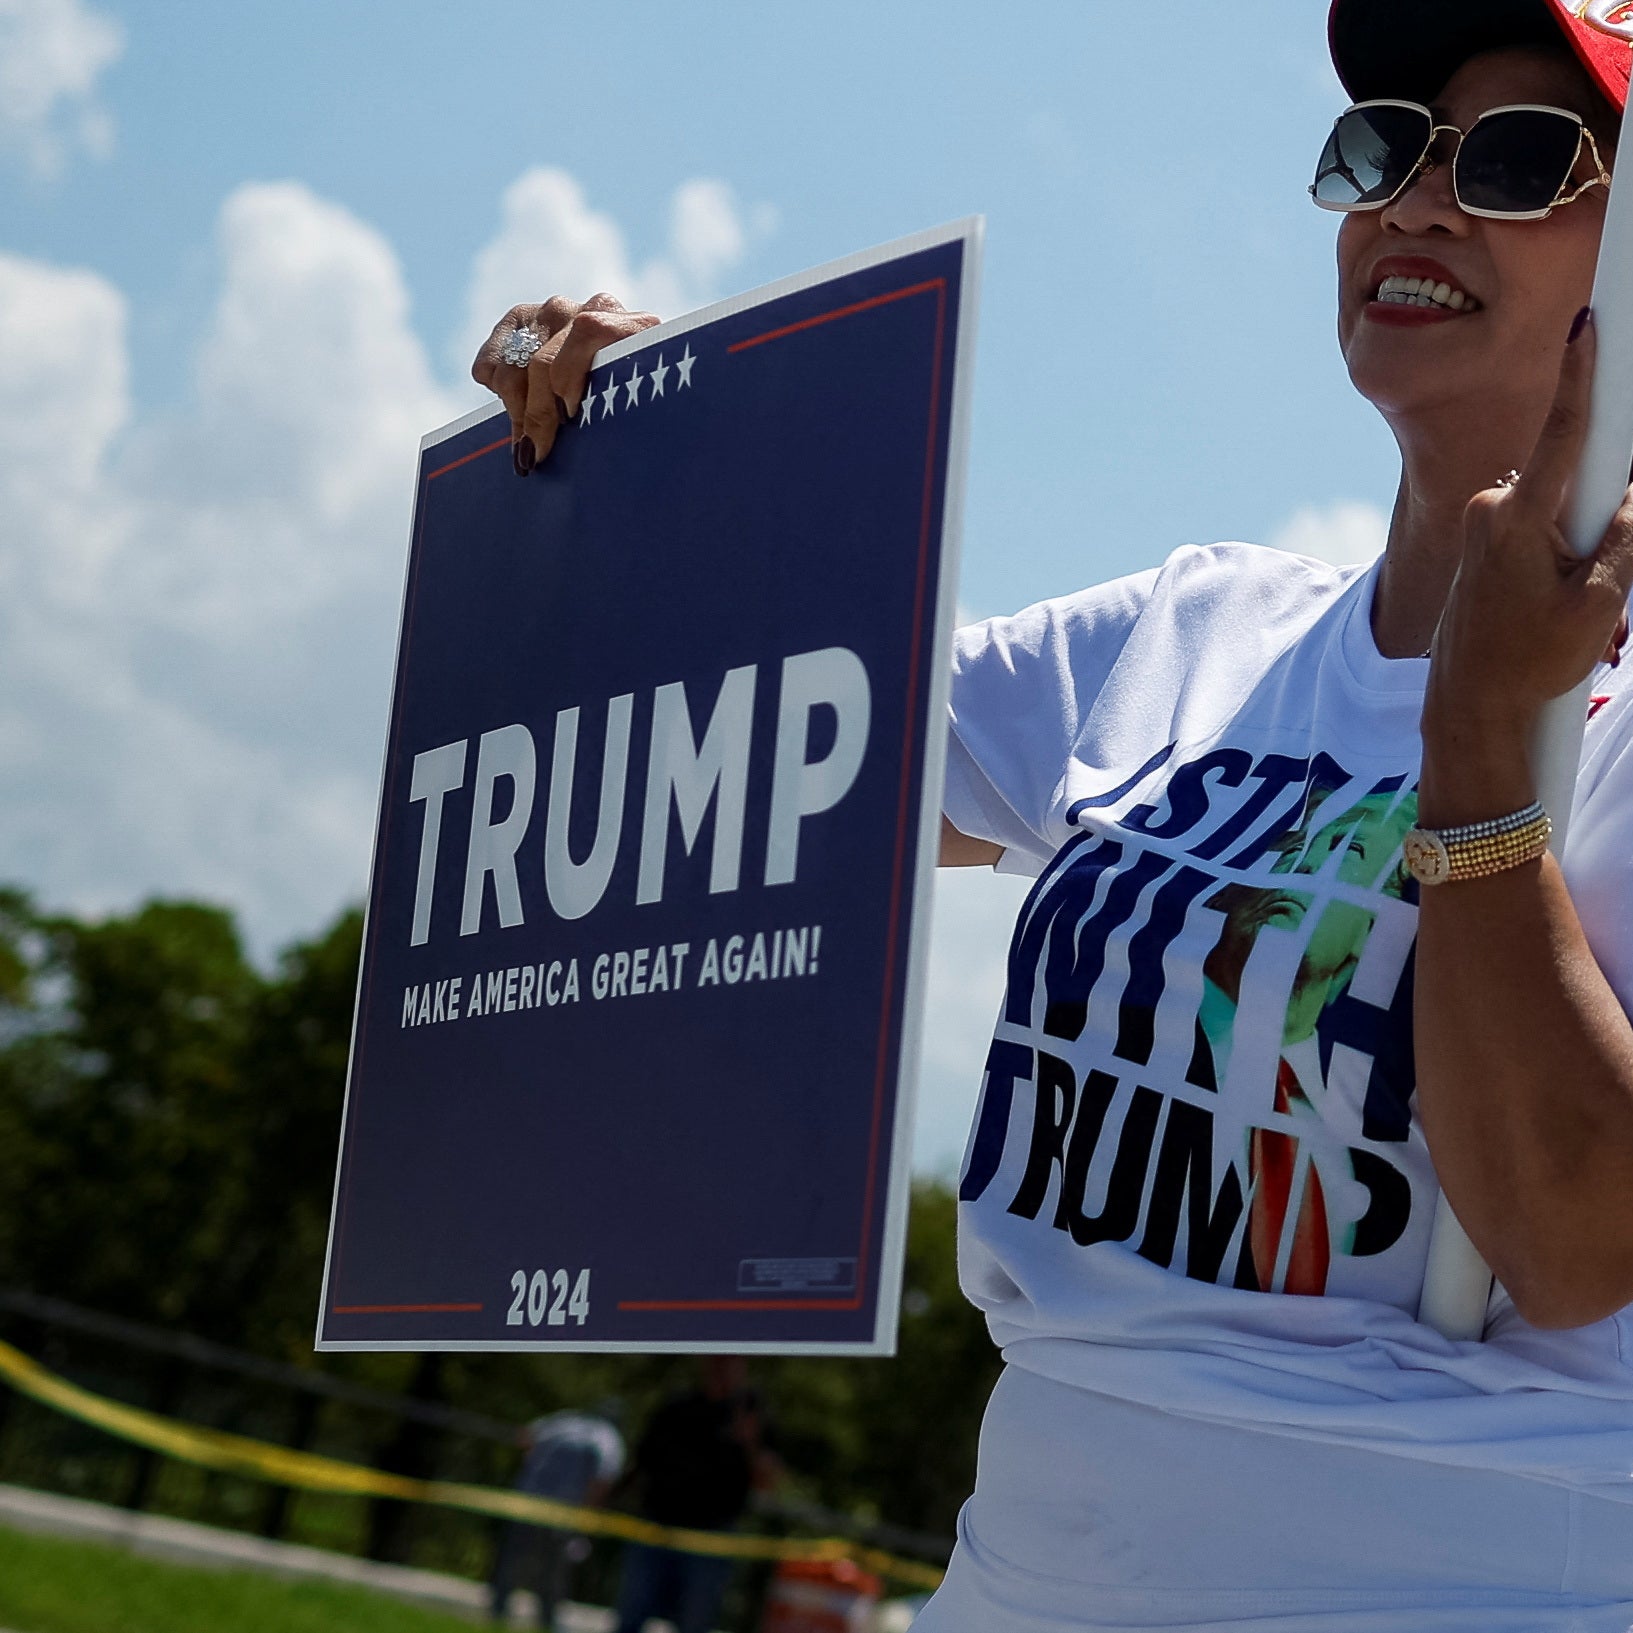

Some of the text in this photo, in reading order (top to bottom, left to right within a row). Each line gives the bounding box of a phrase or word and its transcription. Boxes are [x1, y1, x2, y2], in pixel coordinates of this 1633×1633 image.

[410, 646, 872, 947] TRUMP
[401, 925, 822, 1029] MAKE AMERICA GREAT AGAIN!
[958, 1037, 1412, 1296] TRUMP
[506, 1268, 591, 1327] 2024
